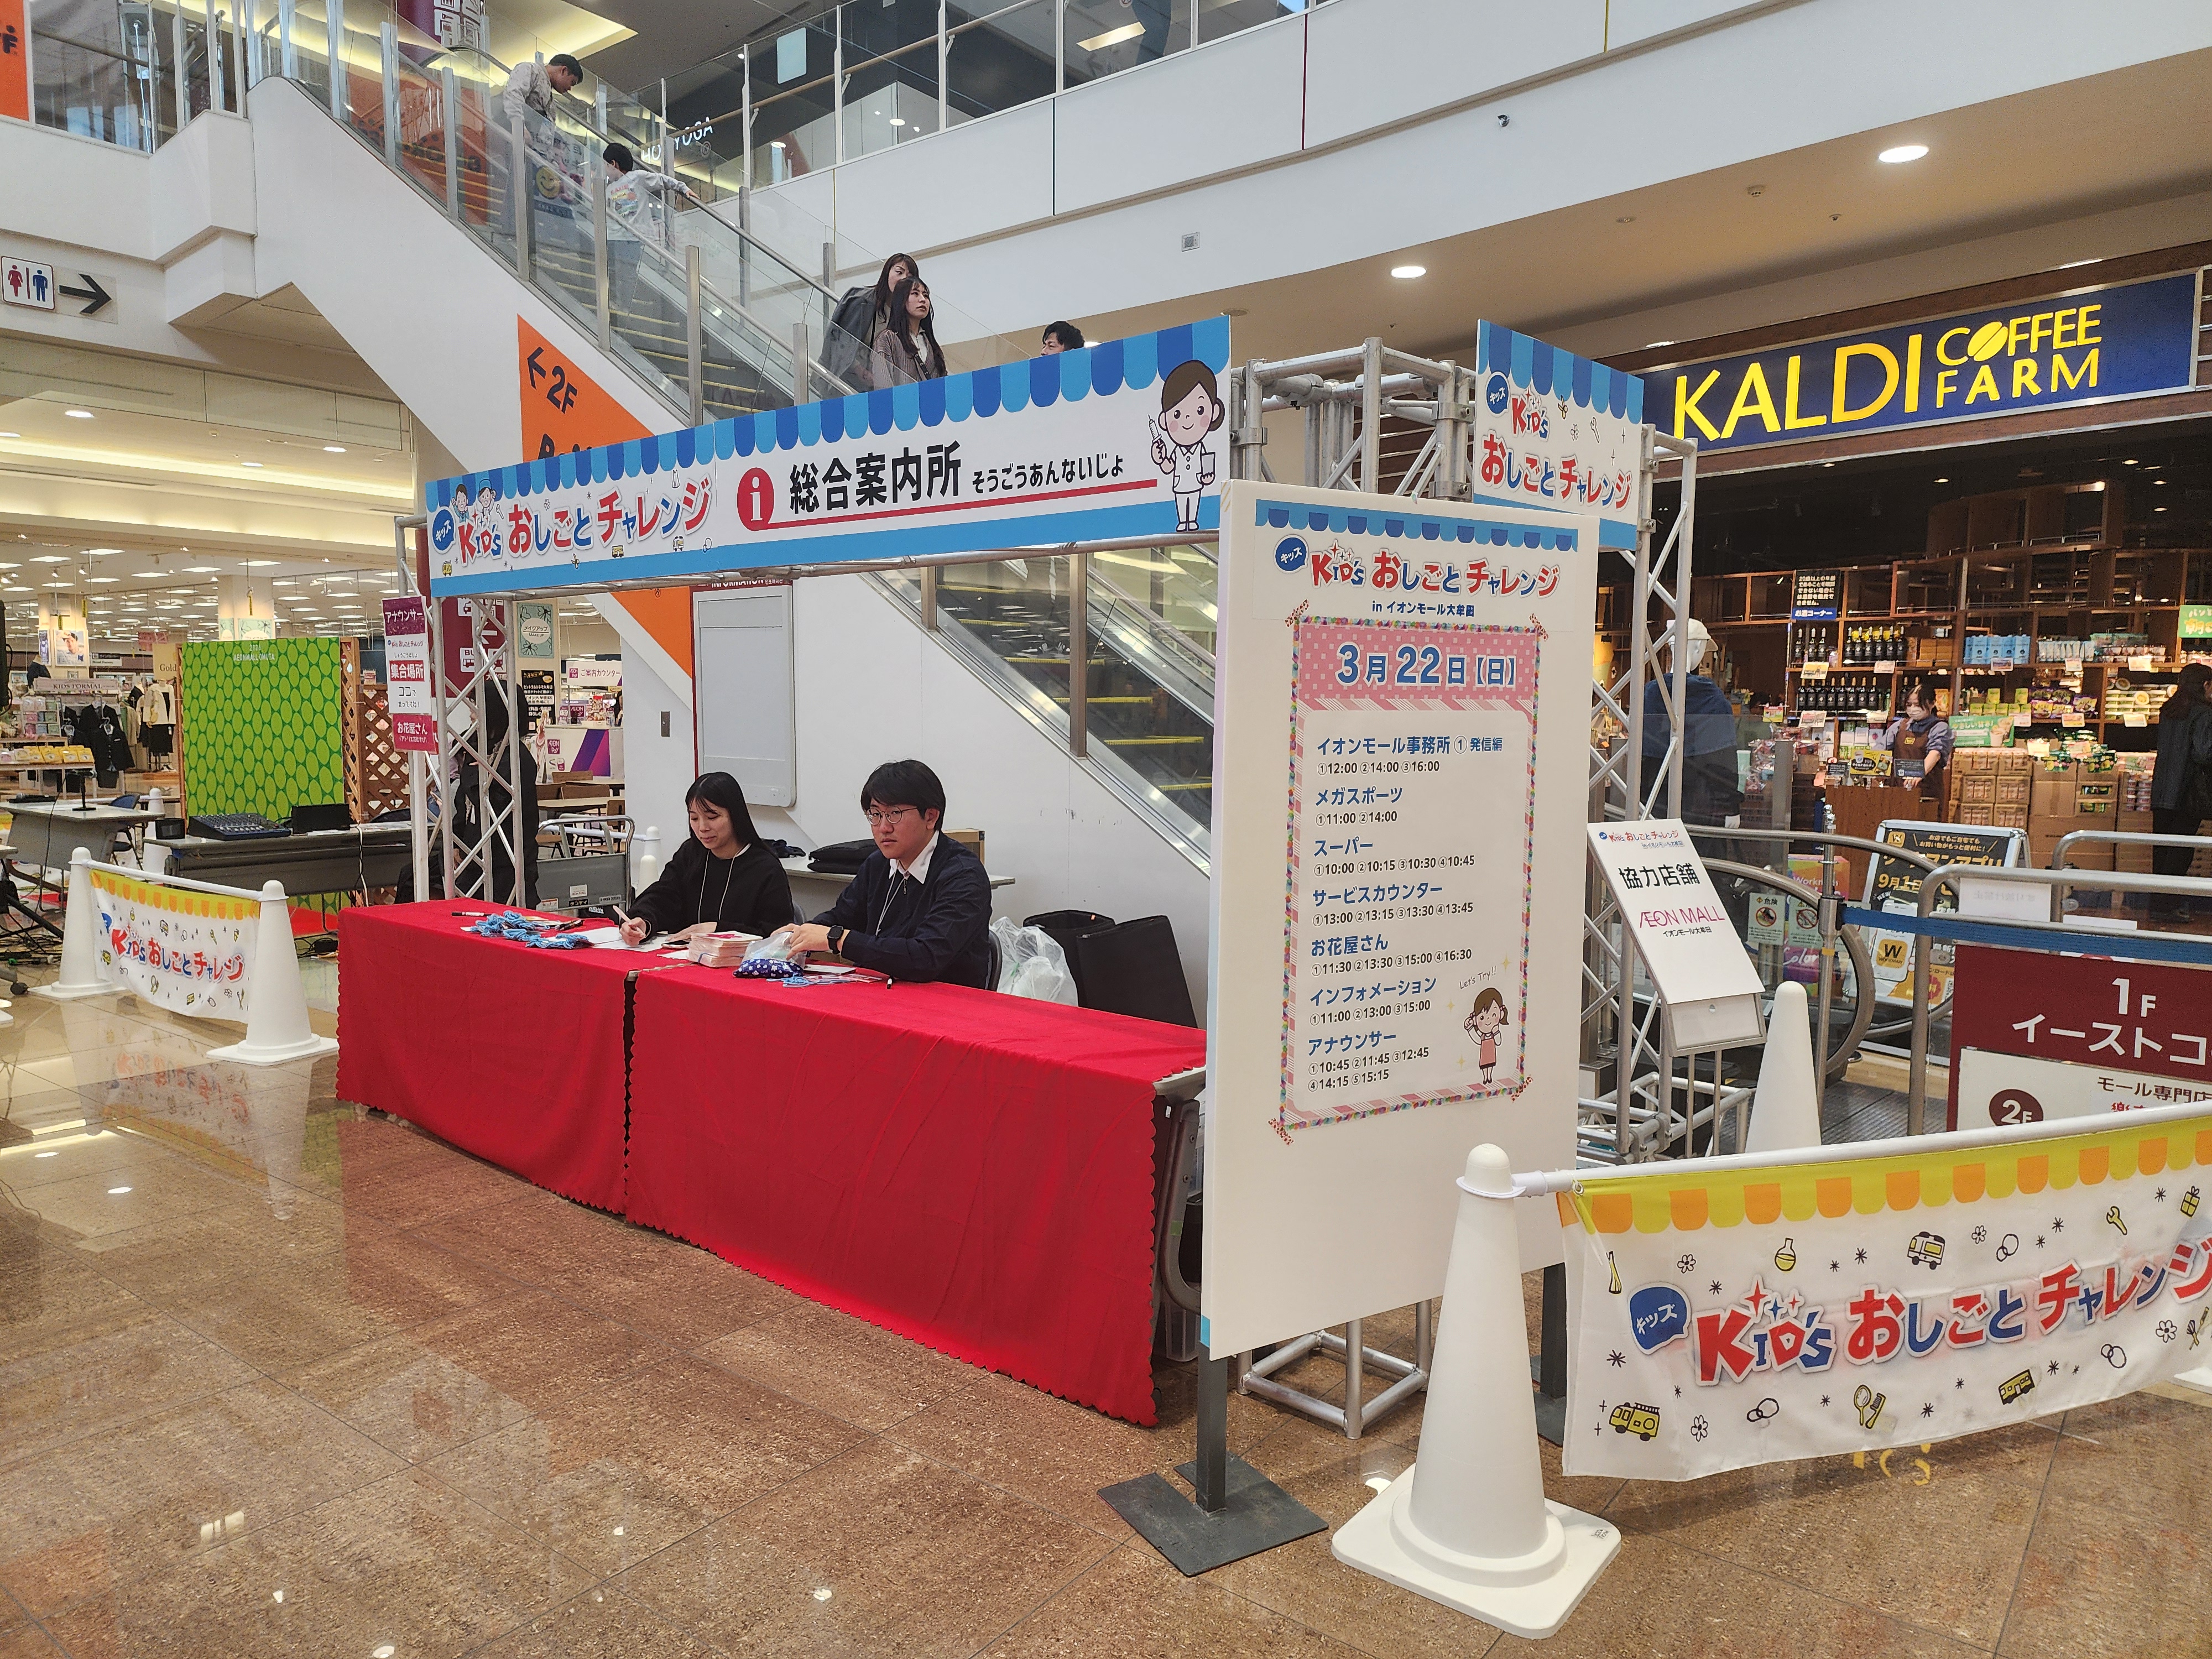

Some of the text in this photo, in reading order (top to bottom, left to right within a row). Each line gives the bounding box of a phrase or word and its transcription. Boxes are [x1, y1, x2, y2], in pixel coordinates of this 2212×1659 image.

[674, 117, 713, 150] YOGA
[1937, 304, 2101, 366] COFFEE
[546, 366, 577, 414] 2F
[1674, 333, 1922, 441] KALDI
[1937, 349, 2099, 409] FARM
[1489, 387, 1506, 405] キッズ
[790, 441, 1124, 514] 総合案内所 そうごうあんないじょ
[1482, 434, 1631, 509] おしごと チャレンジ
[436, 518, 452, 542] キッズ
[508, 504, 592, 554] おしごと
[598, 477, 709, 544] チャレンジ
[1280, 546, 1303, 564] キッズ
[1372, 551, 1460, 593] おしごと
[1467, 561, 1559, 597] チャレンジ
[384, 609, 423, 624] アナウンサー
[1372, 601, 1475, 617] in イオンモール大牟田
[390, 663, 424, 679] 集合場所
[581, 669, 621, 677] ご案内カウンター
[398, 686, 416, 697] ココで
[397, 722, 428, 735] お花屋さん
[1317, 735, 1450, 756] イオンモール事務所
[1470, 737, 1503, 753] 発信編
[1315, 785, 1403, 806] メガスポーツ
[1314, 836, 1373, 857] スーパー
[1625, 831, 1652, 841] おしごと
[1651, 830, 1679, 840] チャレンジ
[1646, 840, 1684, 848] イオンモール大牟田
[1618, 863, 1700, 889] 協力店舗
[1313, 882, 1443, 907] サービスカウンター
[1876, 891, 1892, 901] NEW
[1679, 905, 1725, 924] MALL
[1663, 926, 1713, 937] イオンモール大牟田
[1311, 933, 1389, 957] お花屋さん
[1884, 943, 1903, 958] W
[148, 940, 192, 977] おしごと
[1310, 977, 1437, 1006] インフォメーション
[1459, 976, 1476, 990] Let's
[2112, 977, 2156, 1018] 1F
[1308, 1030, 1397, 1057] アナウンサー
[2012, 1014, 2212, 1066] イーストコ
[2001, 1099, 2032, 1123] 2F
[1635, 1302, 1677, 1334] キッズ
[1846, 1288, 2023, 1361] おしごと
[2038, 1237, 2212, 1332] チャレンジ
